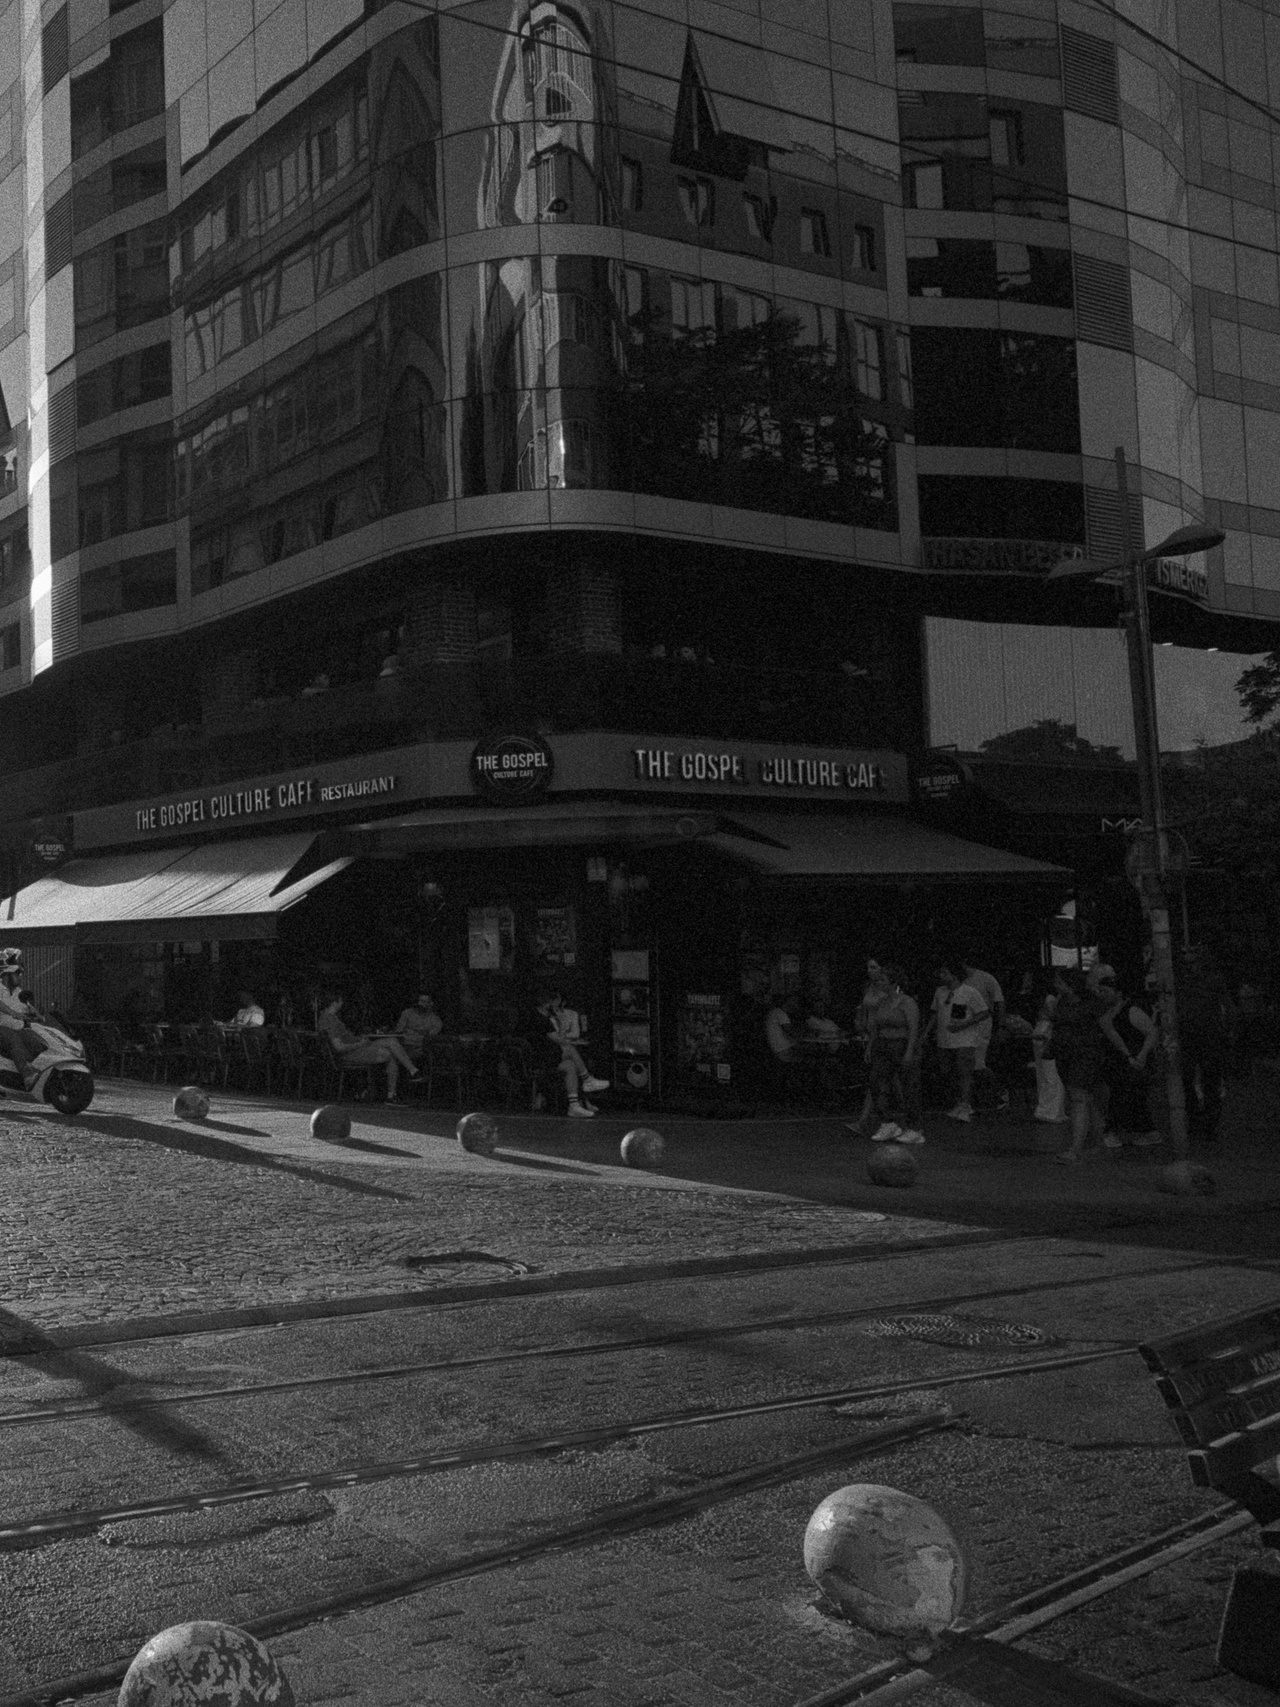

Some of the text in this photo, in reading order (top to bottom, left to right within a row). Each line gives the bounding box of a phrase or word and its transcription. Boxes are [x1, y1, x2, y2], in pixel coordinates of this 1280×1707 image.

[476, 752, 548, 770] THE GOSPEL
[635, 748, 674, 779] THE
[681, 753, 746, 782] GOSPE
[762, 758, 841, 787] CULTURE
[493, 770, 517, 779] CULTURE
[918, 774, 960, 787] THE GOSPEL
[135, 807, 157, 831] THE
[210, 788, 272, 819] CULTURE
[321, 776, 396, 802] RESTAURANT
[34, 843, 66, 852] THE GOSPEL
